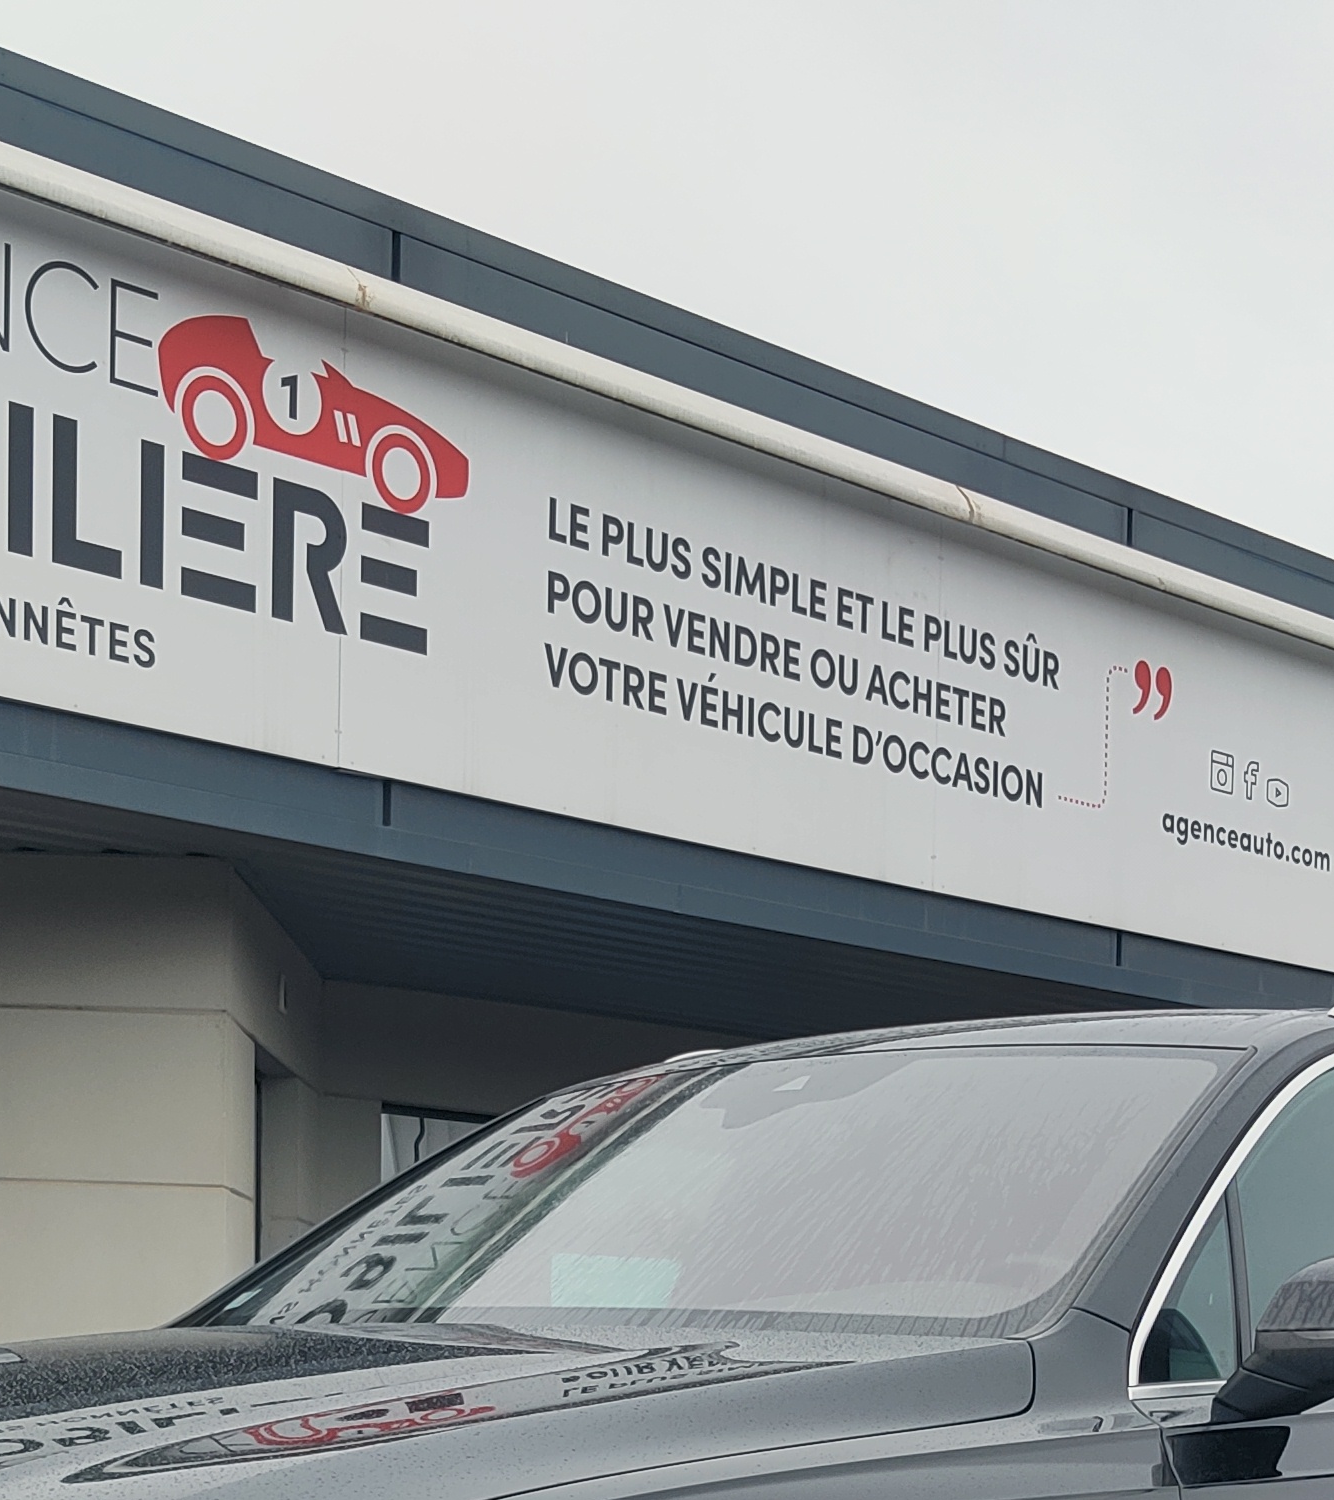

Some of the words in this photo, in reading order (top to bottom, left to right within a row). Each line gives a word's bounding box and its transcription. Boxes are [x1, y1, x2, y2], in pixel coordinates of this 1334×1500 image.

[547, 570, 655, 641] POUR
[663, 603, 802, 684] VENDRE
[811, 648, 859, 698] OU
[867, 660, 1007, 738] ACHETER
[549, 496, 591, 552] LE
[602, 514, 693, 580] PLUS
[701, 546, 828, 622] SIMPLE
[836, 585, 876, 636] ET
[881, 599, 916, 645] LE
[923, 617, 997, 674] PLUS
[1003, 631, 1061, 691] SÛR
[545, 642, 668, 716] VOTRE
[677, 672, 843, 761] VÉHICULE
[852, 727, 1045, 810] D'OCCASION
[1161, 809, 1332, 873] agenceauto.com
